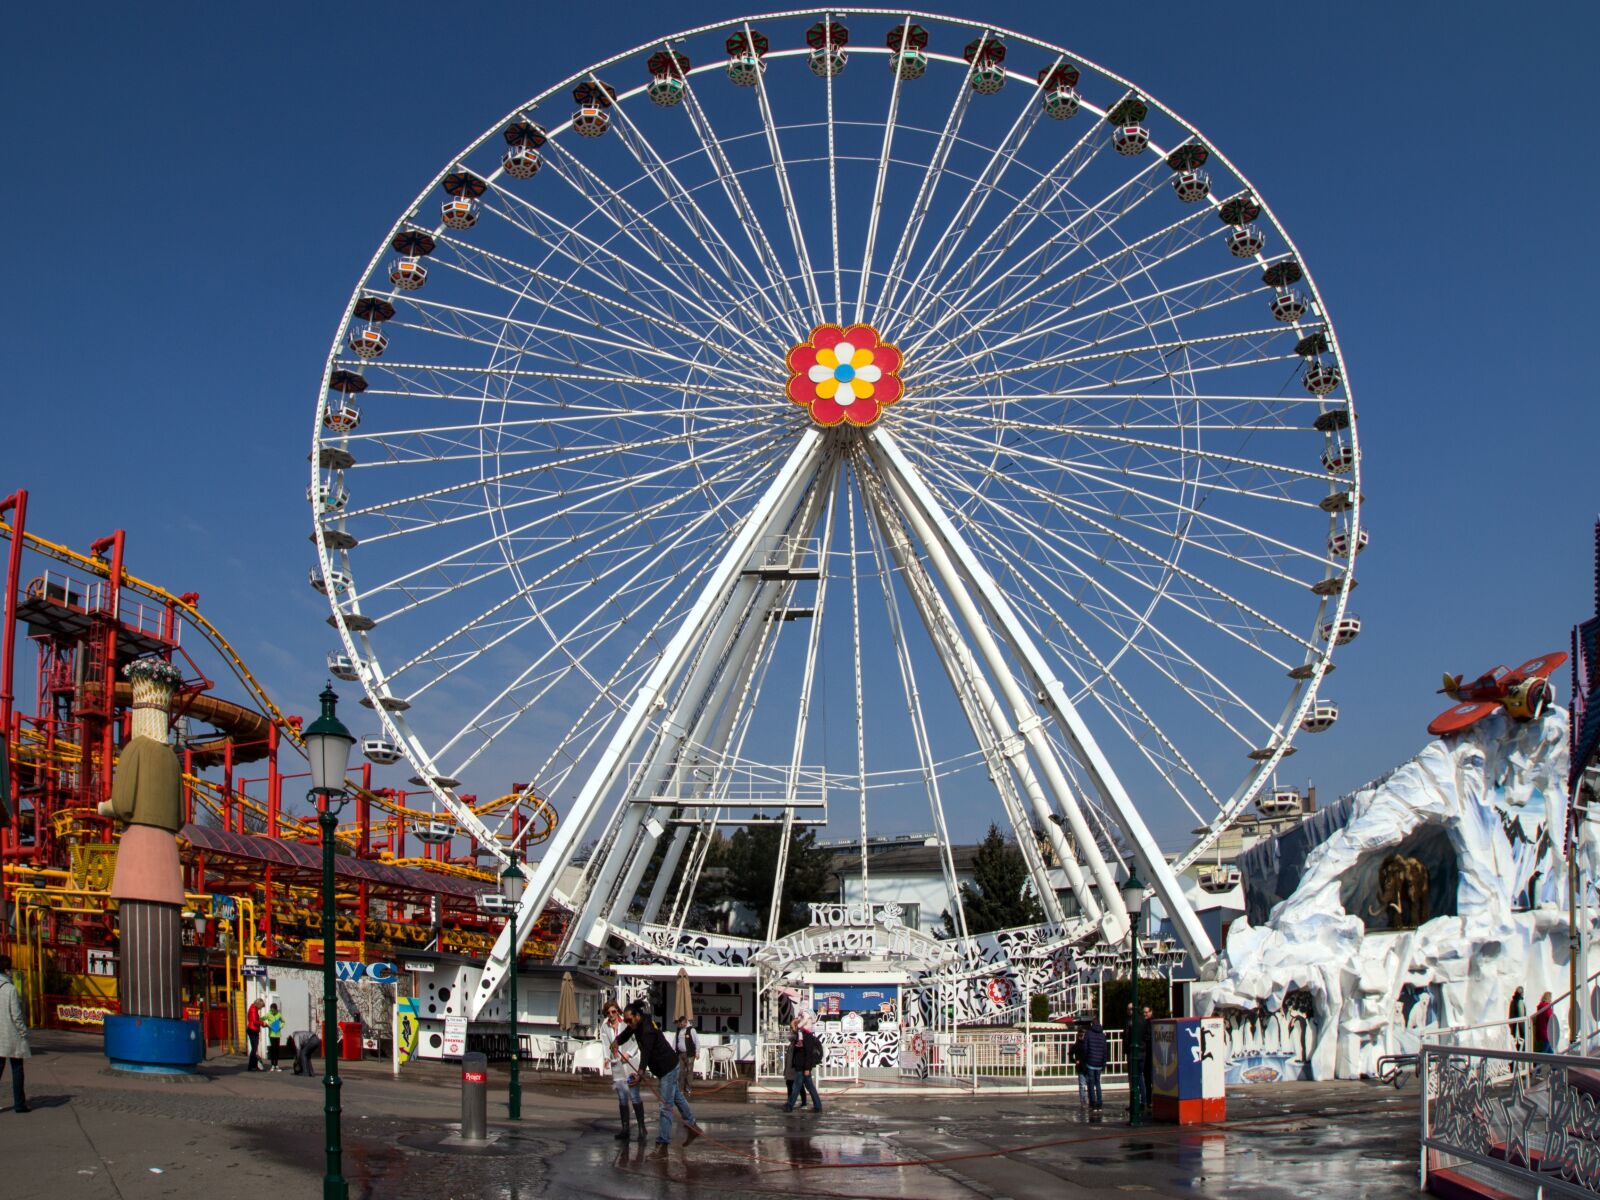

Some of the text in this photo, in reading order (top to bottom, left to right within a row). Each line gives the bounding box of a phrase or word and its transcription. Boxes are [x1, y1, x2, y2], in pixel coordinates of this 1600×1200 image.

[807, 902, 875, 927] Koidl
[775, 929, 947, 964] Blumen Rad
[336, 961, 398, 984] WC
